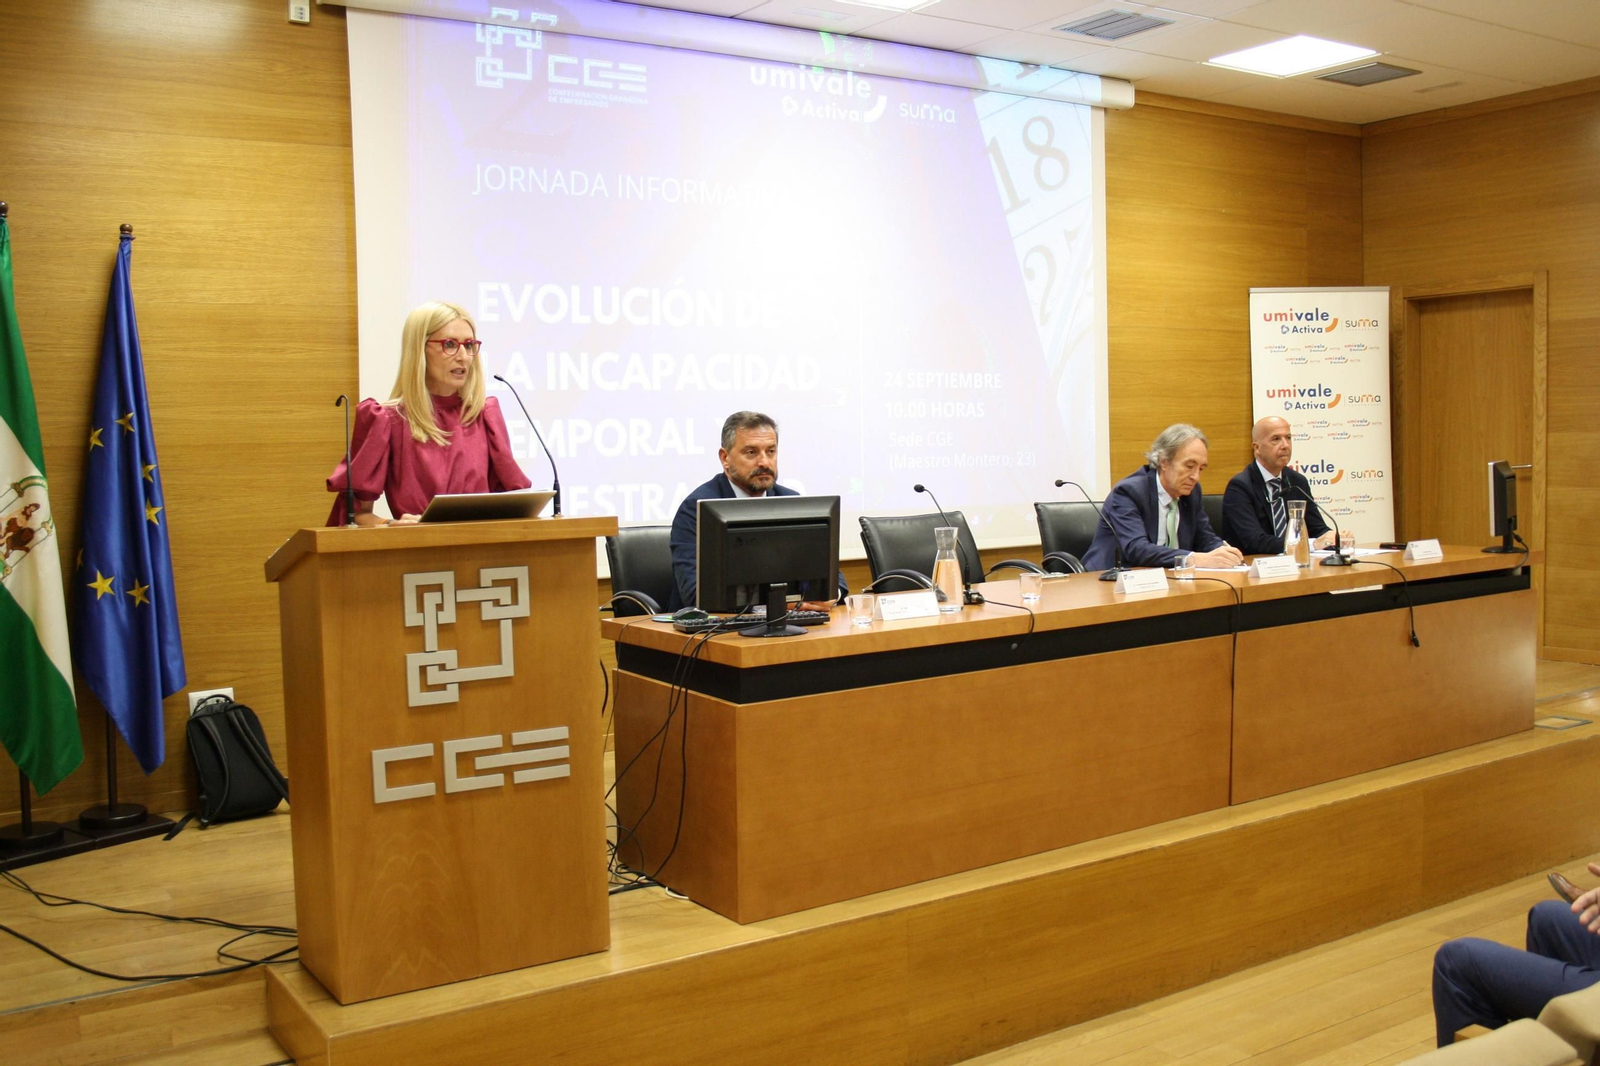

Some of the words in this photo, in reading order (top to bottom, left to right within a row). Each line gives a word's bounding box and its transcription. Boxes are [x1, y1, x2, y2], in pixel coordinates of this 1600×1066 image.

[750, 65, 872, 98] umivale
[802, 99, 860, 122] Activa
[899, 103, 956, 123] suma
[471, 163, 609, 198] JORNADA
[477, 276, 722, 327] EVOLUCIÓN
[736, 290, 781, 329] DE
[1263, 307, 1330, 322] umivale
[1292, 325, 1323, 334] Activa
[1345, 319, 1379, 328] suma
[480, 350, 535, 391] LA
[547, 351, 821, 392] INCAPACIDAD
[884, 372, 903, 388] 24
[907, 372, 1002, 389] SEPTIEMBRE
[1266, 383, 1332, 398] umivale
[1348, 394, 1381, 403] suma
[885, 402, 926, 418] 10.00
[931, 402, 985, 418] HORAS
[1294, 401, 1326, 410] Activa
[508, 417, 705, 459] EMPORAL
[889, 432, 923, 447] Sede
[927, 431, 955, 446] CGE
[889, 452, 950, 471] (Maestro
[954, 453, 1013, 468] Montero,
[1017, 451, 1037, 467] 23)
[1289, 459, 1335, 473] ivale
[1309, 477, 1329, 485] tiva
[1351, 470, 1384, 478] suma
[372, 726, 571, 804] CGE
